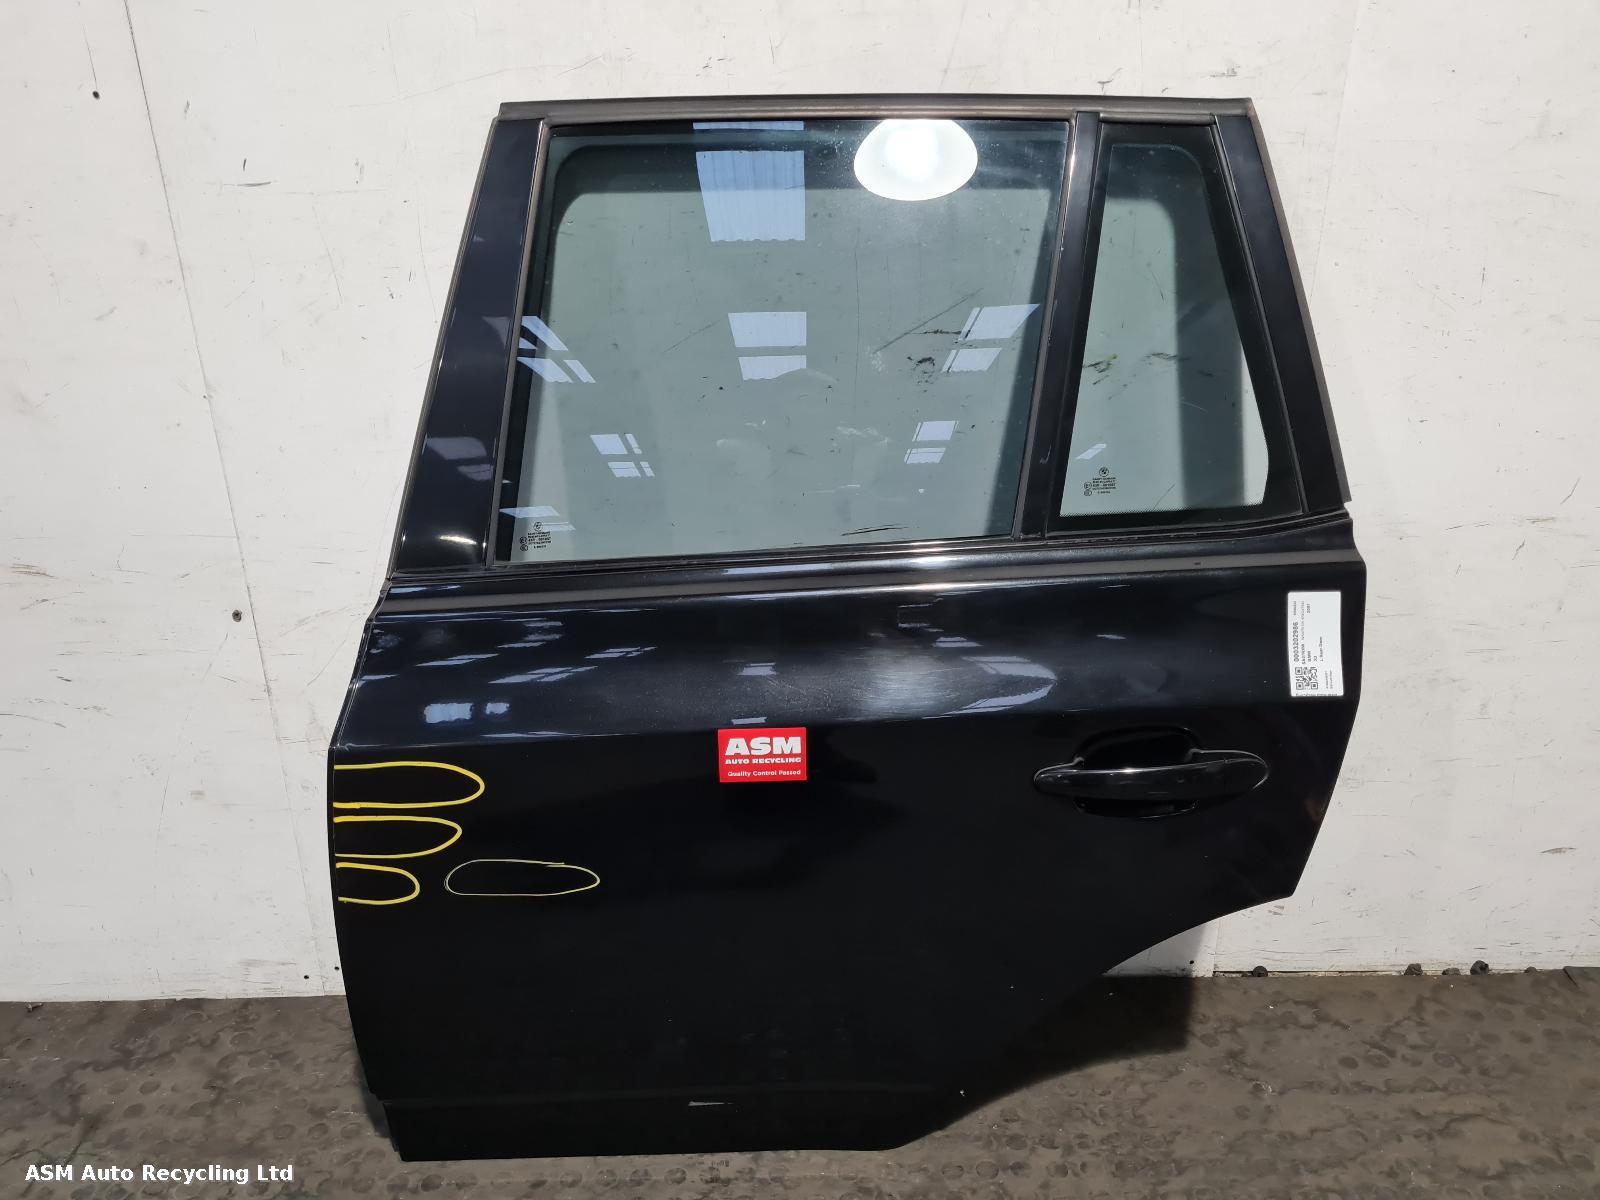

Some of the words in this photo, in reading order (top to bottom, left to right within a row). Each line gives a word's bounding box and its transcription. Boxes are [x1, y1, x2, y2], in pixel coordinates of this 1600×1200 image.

[1292, 621, 1300, 662] 0003202986
[725, 736, 801, 756] ASM
[752, 769, 777, 777] Control
